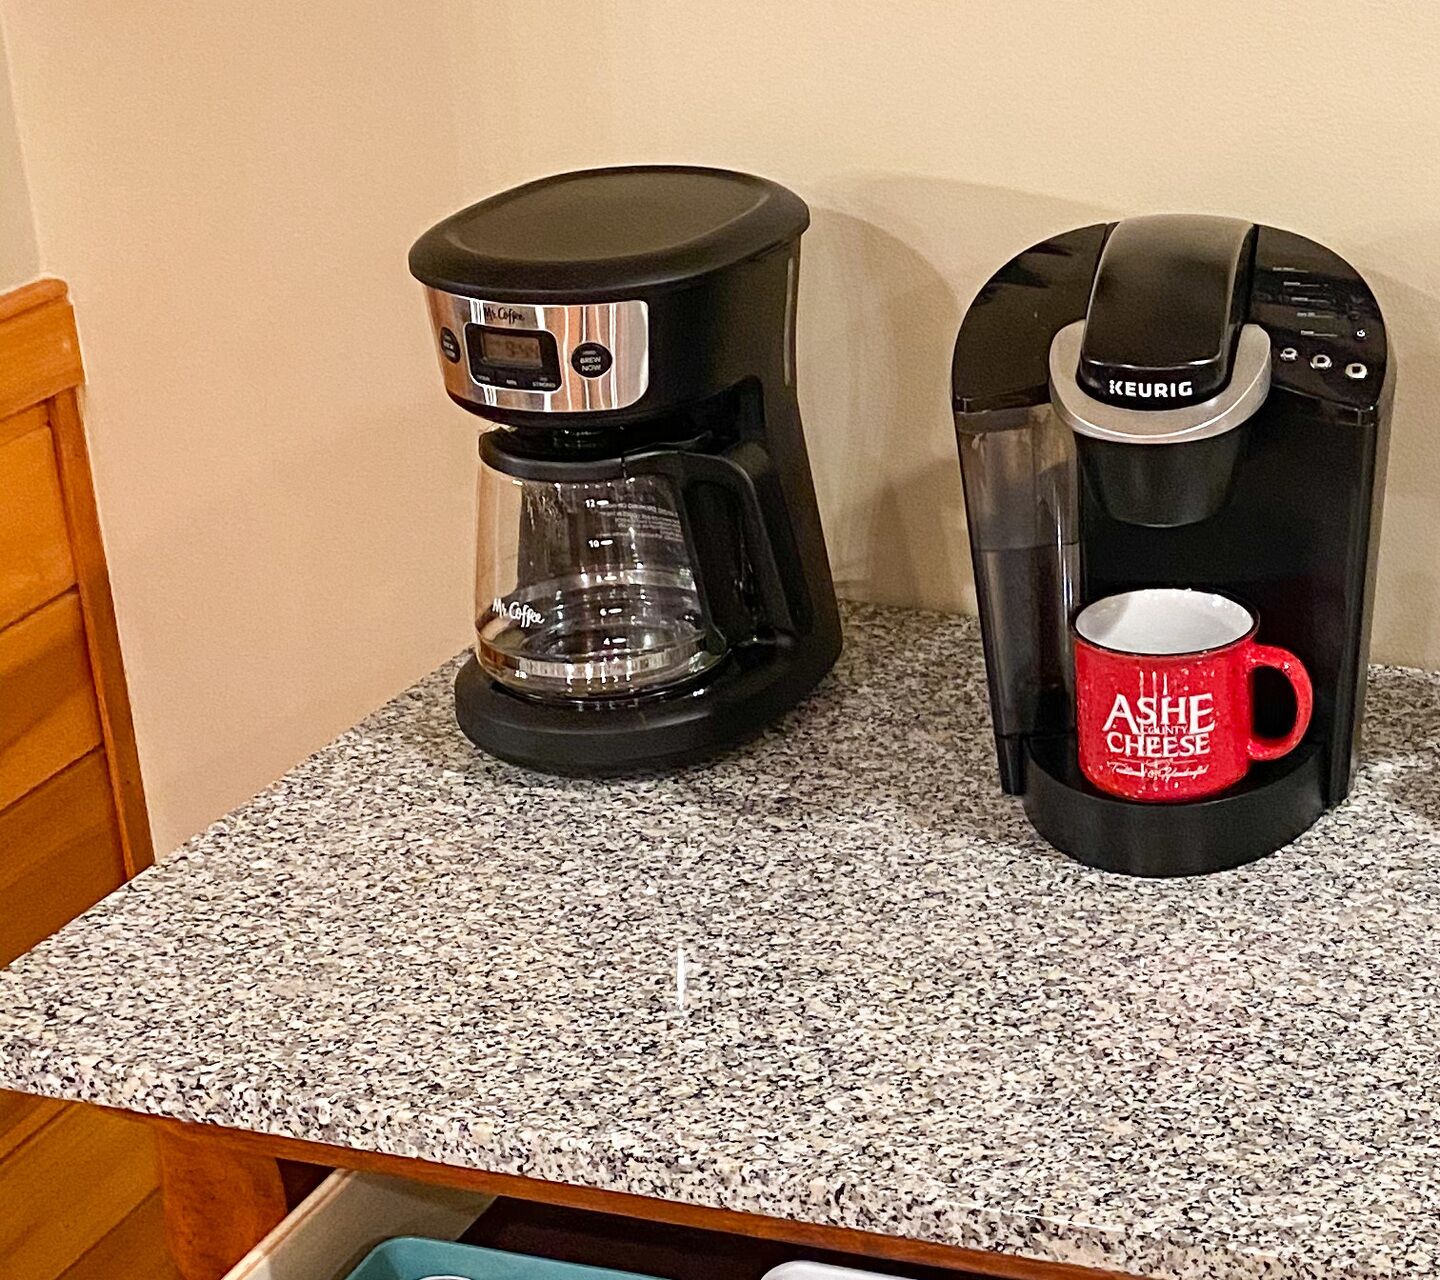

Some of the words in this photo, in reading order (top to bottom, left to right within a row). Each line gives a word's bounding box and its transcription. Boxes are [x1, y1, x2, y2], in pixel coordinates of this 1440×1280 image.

[1109, 379, 1194, 398] KEURIG
[585, 499, 595, 508] 12
[589, 539, 600, 549] 10
[509, 601, 546, 628] Coffee
[1102, 693, 1216, 735] ASHE
[1106, 731, 1211, 757] CHEESE
